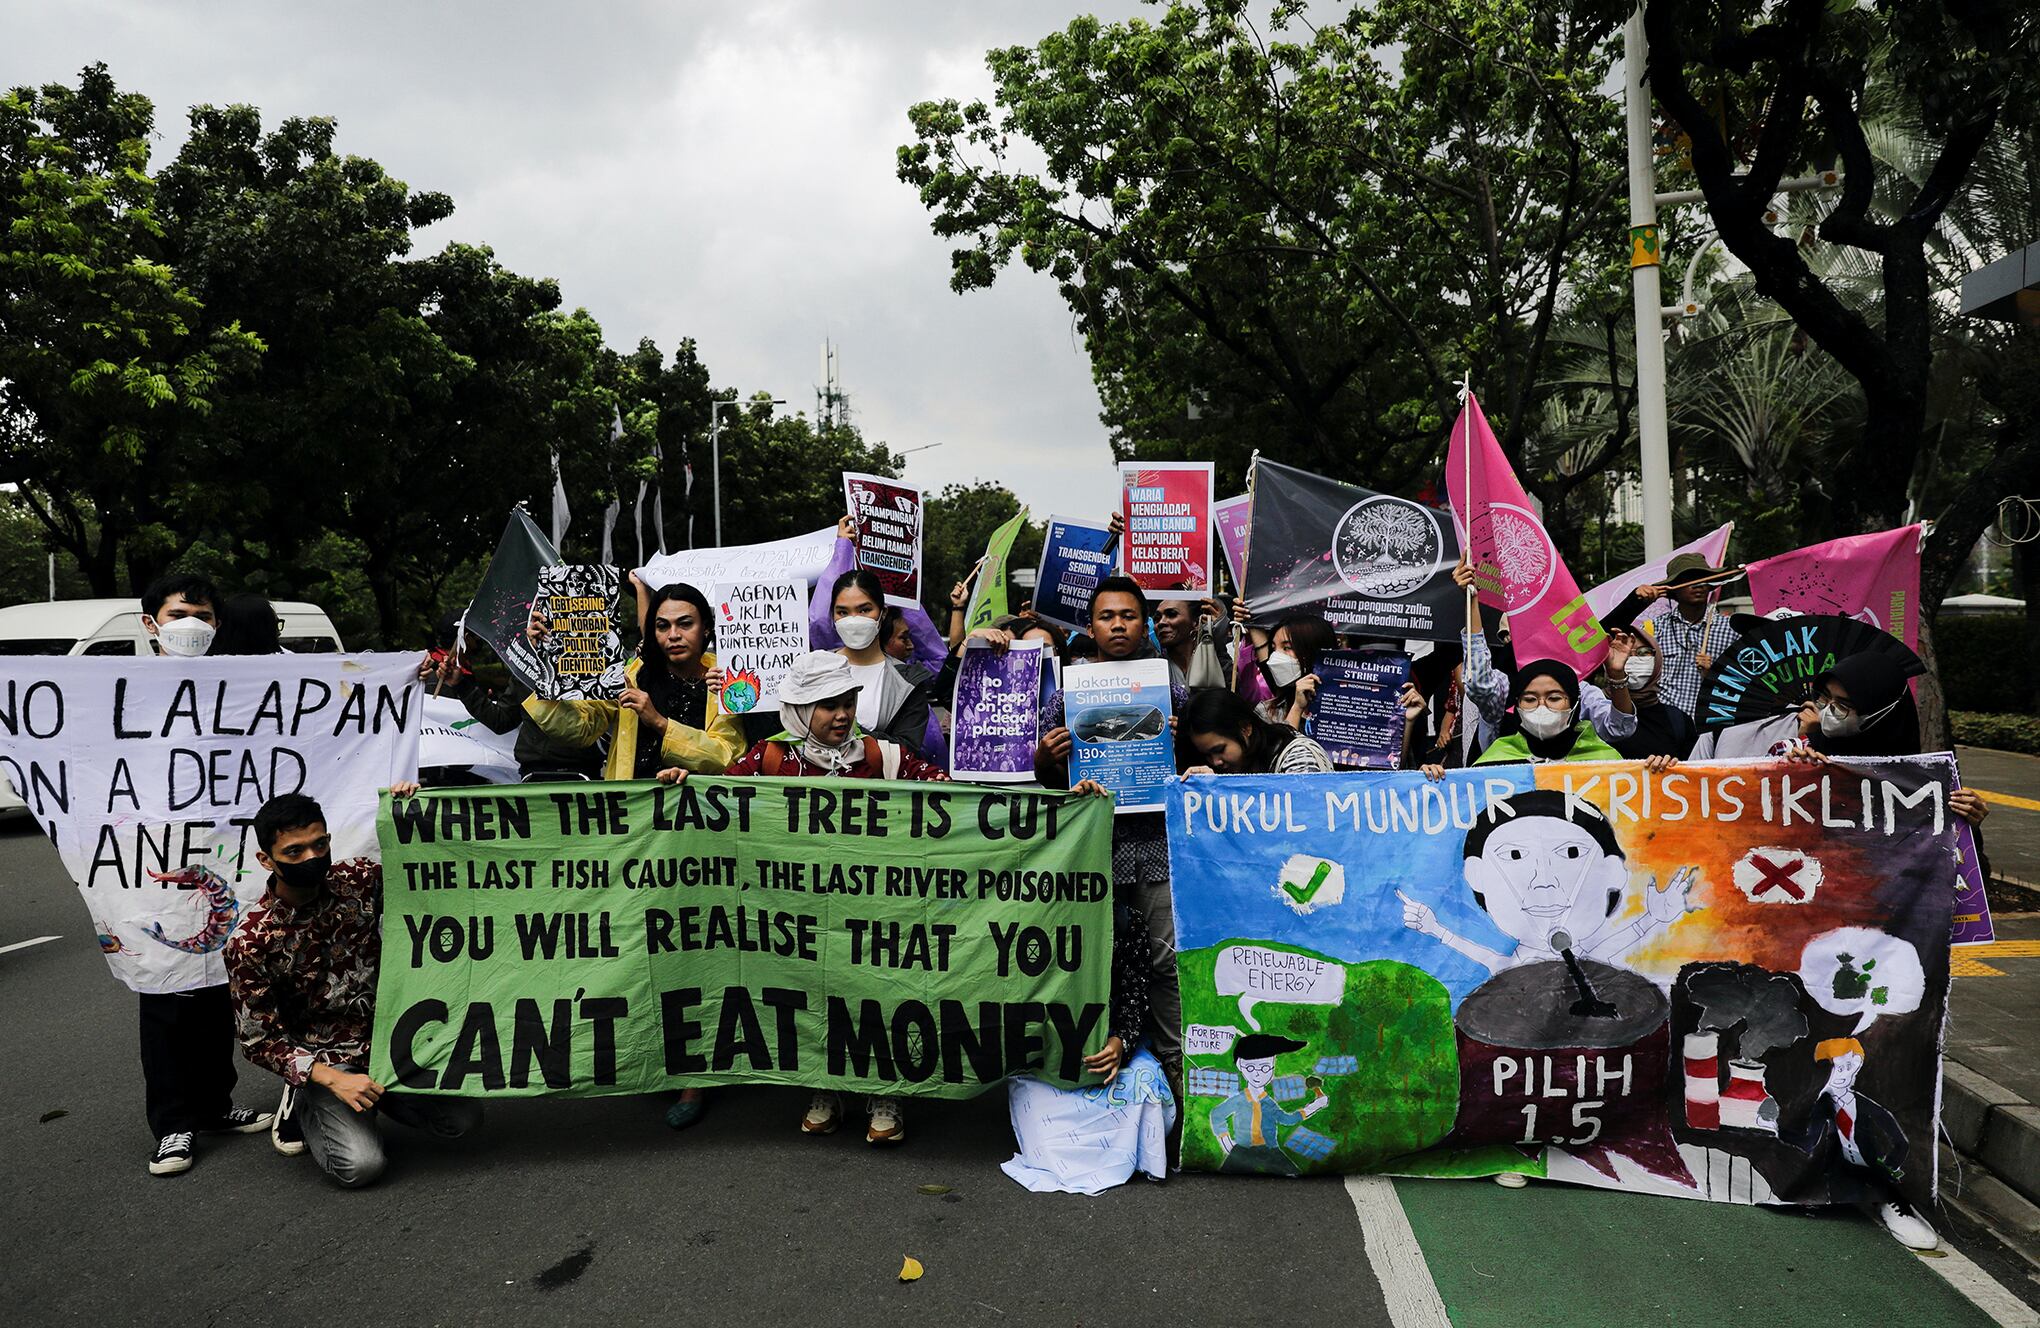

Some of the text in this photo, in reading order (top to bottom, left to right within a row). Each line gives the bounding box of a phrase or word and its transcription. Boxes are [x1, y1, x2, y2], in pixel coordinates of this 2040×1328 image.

[1130, 488, 1161, 502] WARIA
[859, 503, 914, 526] PENAMPUNGAN
[1131, 503, 1191, 516] MENGHADAPI
[871, 520, 904, 539] BENCANA
[1131, 517, 1194, 531] BEBAN GANDA
[861, 534, 912, 557] BELUM RAMAH
[1131, 532, 1182, 546] CAMPURAN
[860, 550, 912, 572] TRANSGENDER
[1058, 546, 1110, 565] TRANSGENDER
[1131, 547, 1190, 560] KELAS BERAT
[1068, 561, 1096, 575] SERING
[1131, 561, 1182, 575] MARATHON
[1062, 572, 1098, 588] DITUDUH
[730, 585, 797, 602] AGENDA
[1057, 583, 1095, 599] PENYEBA
[550, 596, 605, 612] LGBT SERING
[740, 603, 782, 621] IKLIM
[1326, 597, 1433, 618] Lawan penguasa zalim,
[553, 617, 608, 632] JADI KORBAN
[1324, 610, 1433, 630] tegakkan keadilan iklim
[719, 622, 799, 635] TIDAK BOLEH
[168, 633, 199, 649] PILIH
[564, 638, 598, 652] POLITIK
[719, 637, 804, 650] DIINTERVENSI
[559, 658, 605, 673] IDENTITAS
[1323, 656, 1403, 675] GLOBAL CLIMATE
[1759, 652, 1837, 695] PUNA
[982, 675, 1002, 688] no
[1074, 675, 1130, 689] Jakarta
[1343, 669, 1379, 682] STRIKE
[1347, 683, 1372, 691] INDONESIA
[982, 686, 1028, 706] k-pop
[1075, 691, 1132, 705] Sinking
[113, 677, 412, 739] LALAPAN
[975, 703, 1013, 713] on a
[990, 709, 1028, 723] dead
[972, 721, 1025, 738] planet.
[1078, 748, 1107, 760] 130x
[107, 757, 140, 813] A
[168, 746, 307, 811] DEAD
[1184, 770, 1943, 837] PUKUL MUNDUR KRISIS IKLIM
[391, 784, 1067, 845] WHEN THE LAST TREE IS CUT
[402, 856, 1109, 903] THE LAST FISH CAUGHT, THE LAST RIVER POISONED
[403, 905, 1083, 978] YOU WILL REALISE THAT YOU
[1232, 947, 1325, 976] RENEWABLE
[1248, 968, 1316, 994] ENERGY
[390, 985, 1107, 1092] CAN'T EAT MONEY
[1191, 1026, 1207, 1039] FOR
[1188, 1037, 1221, 1050] FUTURE
[1493, 1053, 1633, 1099] PILIH
[1515, 1101, 1605, 1145] 1.5
